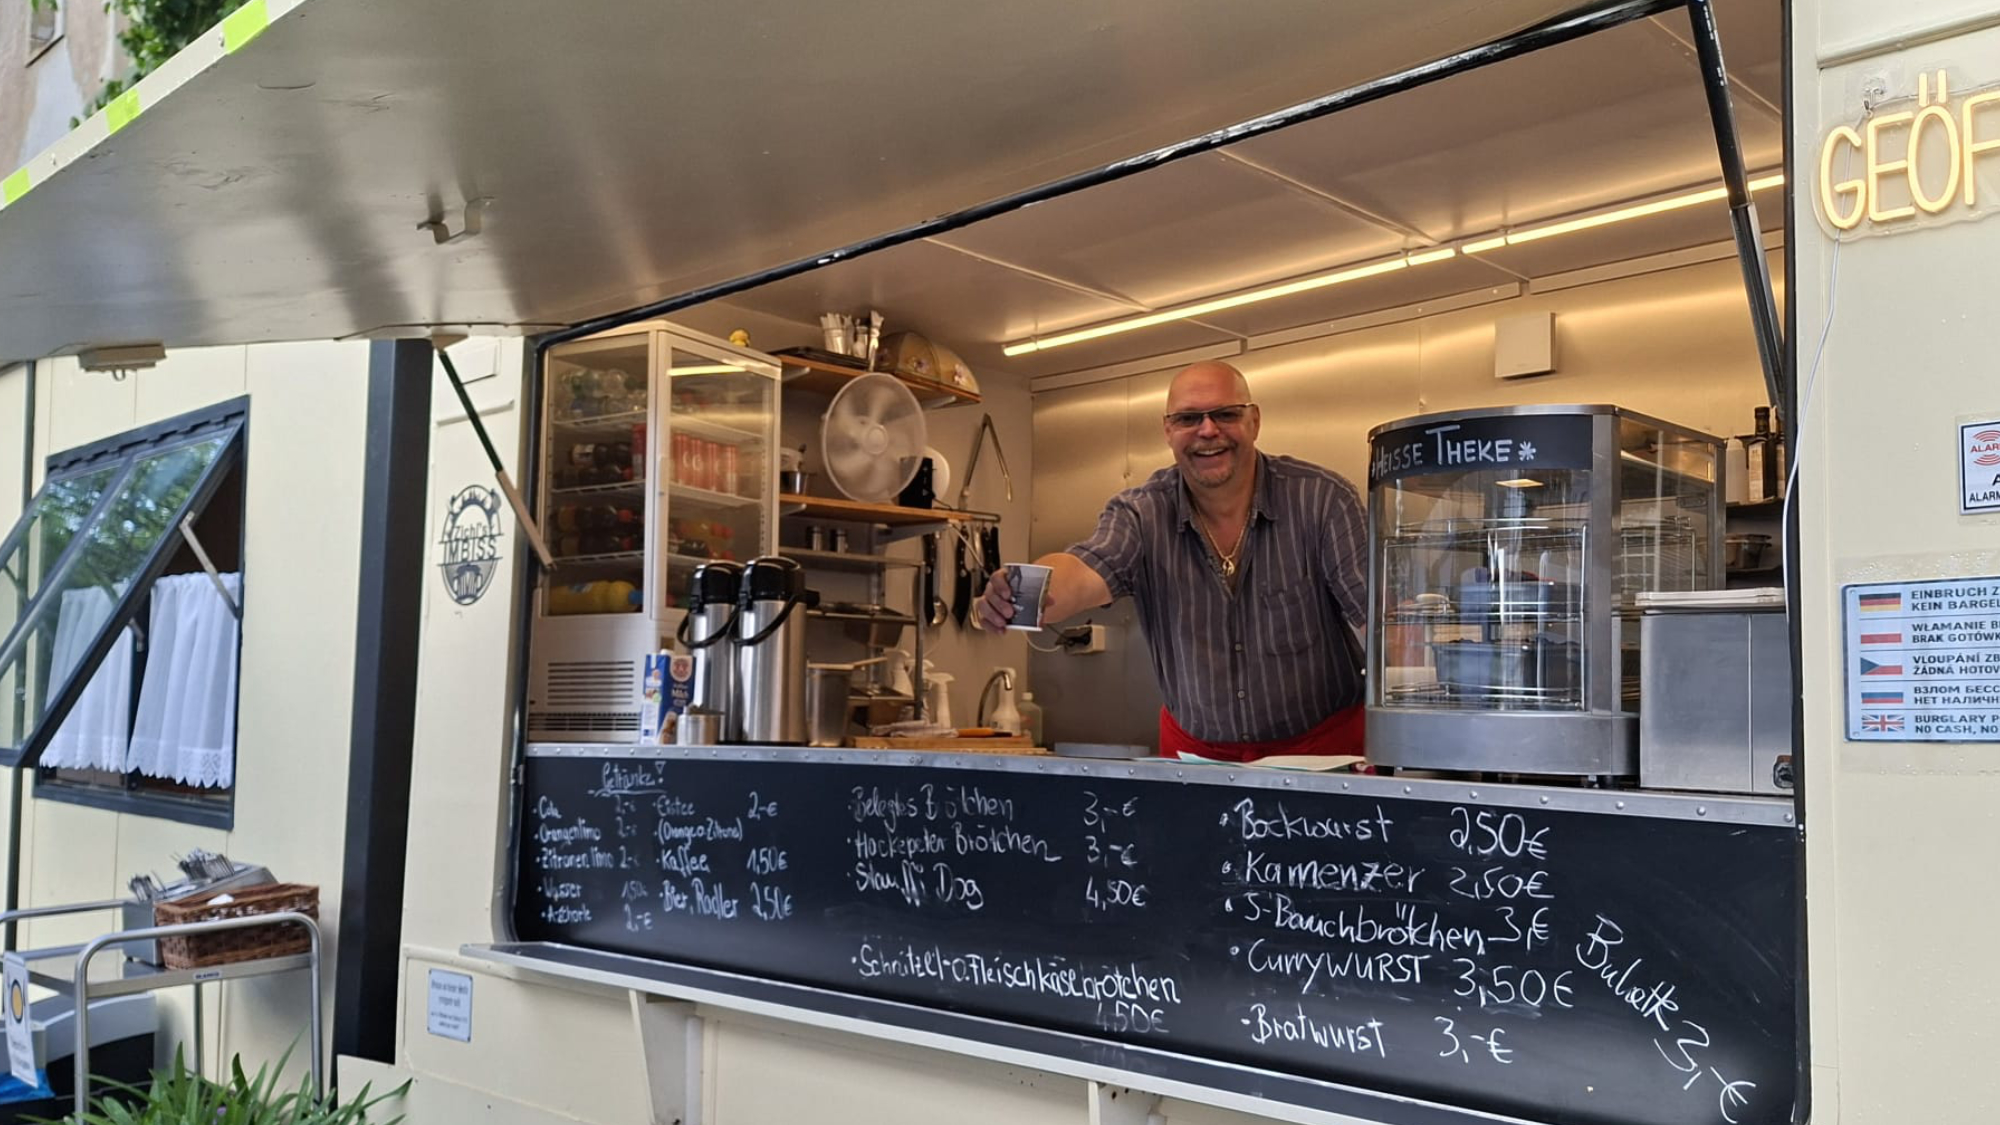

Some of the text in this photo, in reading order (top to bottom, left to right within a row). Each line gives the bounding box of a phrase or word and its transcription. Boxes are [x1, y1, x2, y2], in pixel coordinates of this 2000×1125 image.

[1970, 443, 2000, 454] ALAR
[1376, 443, 1423, 480] HEISSE
[1911, 587, 1987, 600] EINBRUCH
[1911, 602, 1943, 612] KEIN
[1912, 620, 2000, 633] WŁAMANIE B
[1912, 631, 2000, 644] BRAK GOTÓWK
[1913, 651, 1981, 665] VLOUPÁNÍ
[1913, 663, 2000, 676] ŽÁDNÁ HOTOV
[1914, 684, 2000, 695] ВЗЛОМ БЕСС
[1914, 695, 2000, 705] НЕТ НАЛИЧН
[1915, 714, 1986, 724] BURGLARY
[1915, 725, 1999, 735] NO CASH, NO
[657, 795, 695, 817] Eistee
[920, 783, 1013, 822] Bötchen
[1234, 797, 1394, 843] Bockwurst
[951, 821, 1062, 862] Brötchen
[662, 845, 711, 878] Kaffee
[1246, 850, 1426, 892] Kamenzer
[932, 861, 984, 910] Dog
[1248, 1002, 1387, 1059] Bratwurst
